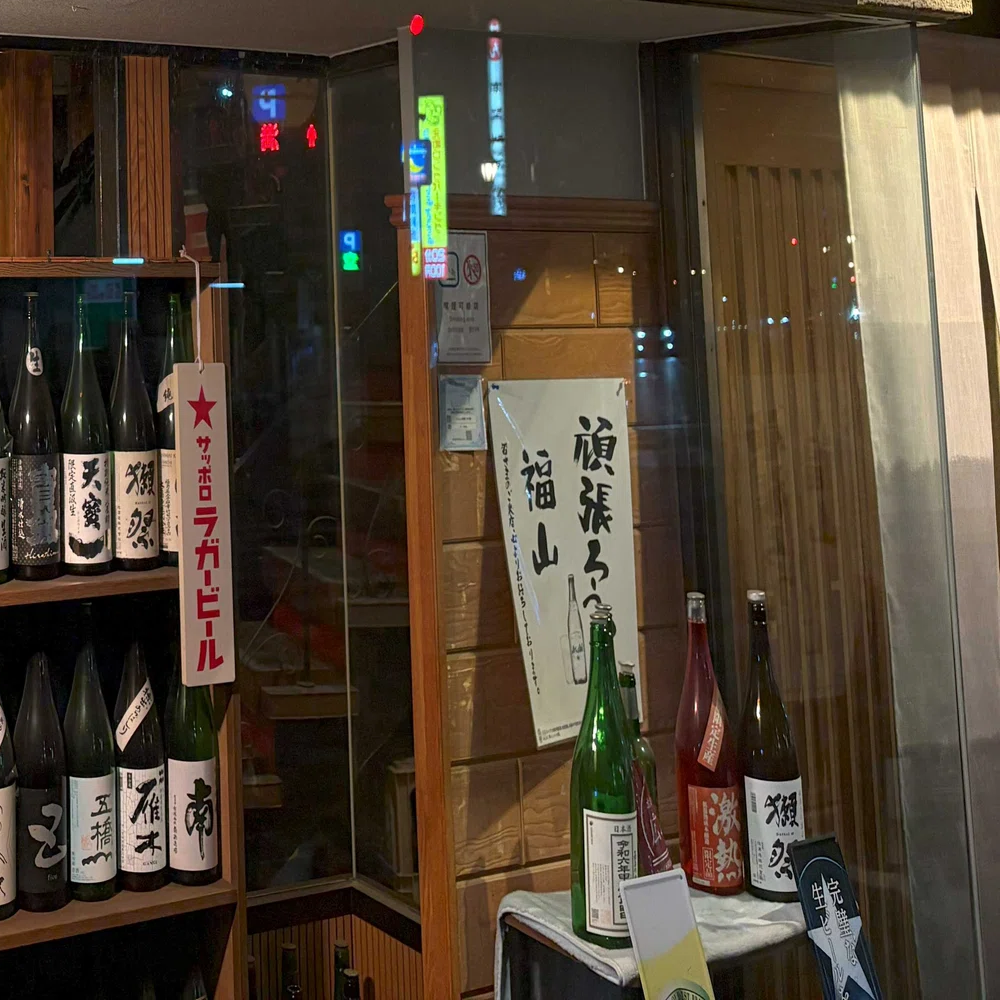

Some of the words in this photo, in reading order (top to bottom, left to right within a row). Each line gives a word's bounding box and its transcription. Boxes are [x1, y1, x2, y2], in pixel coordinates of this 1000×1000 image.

[125, 460, 157, 550] 獺祭
[521, 449, 559, 576] 福山
[574, 416, 617, 608] 頑張ろう
[193, 436, 224, 672] サッポロラガービール
[90, 793, 114, 852] 五橋
[130, 778, 162, 856] 雁木
[184, 777, 214, 861] 南
[613, 825, 632, 833] 日本酒
[764, 791, 799, 880] 獺祭
[616, 839, 631, 920] 令和六年甲
